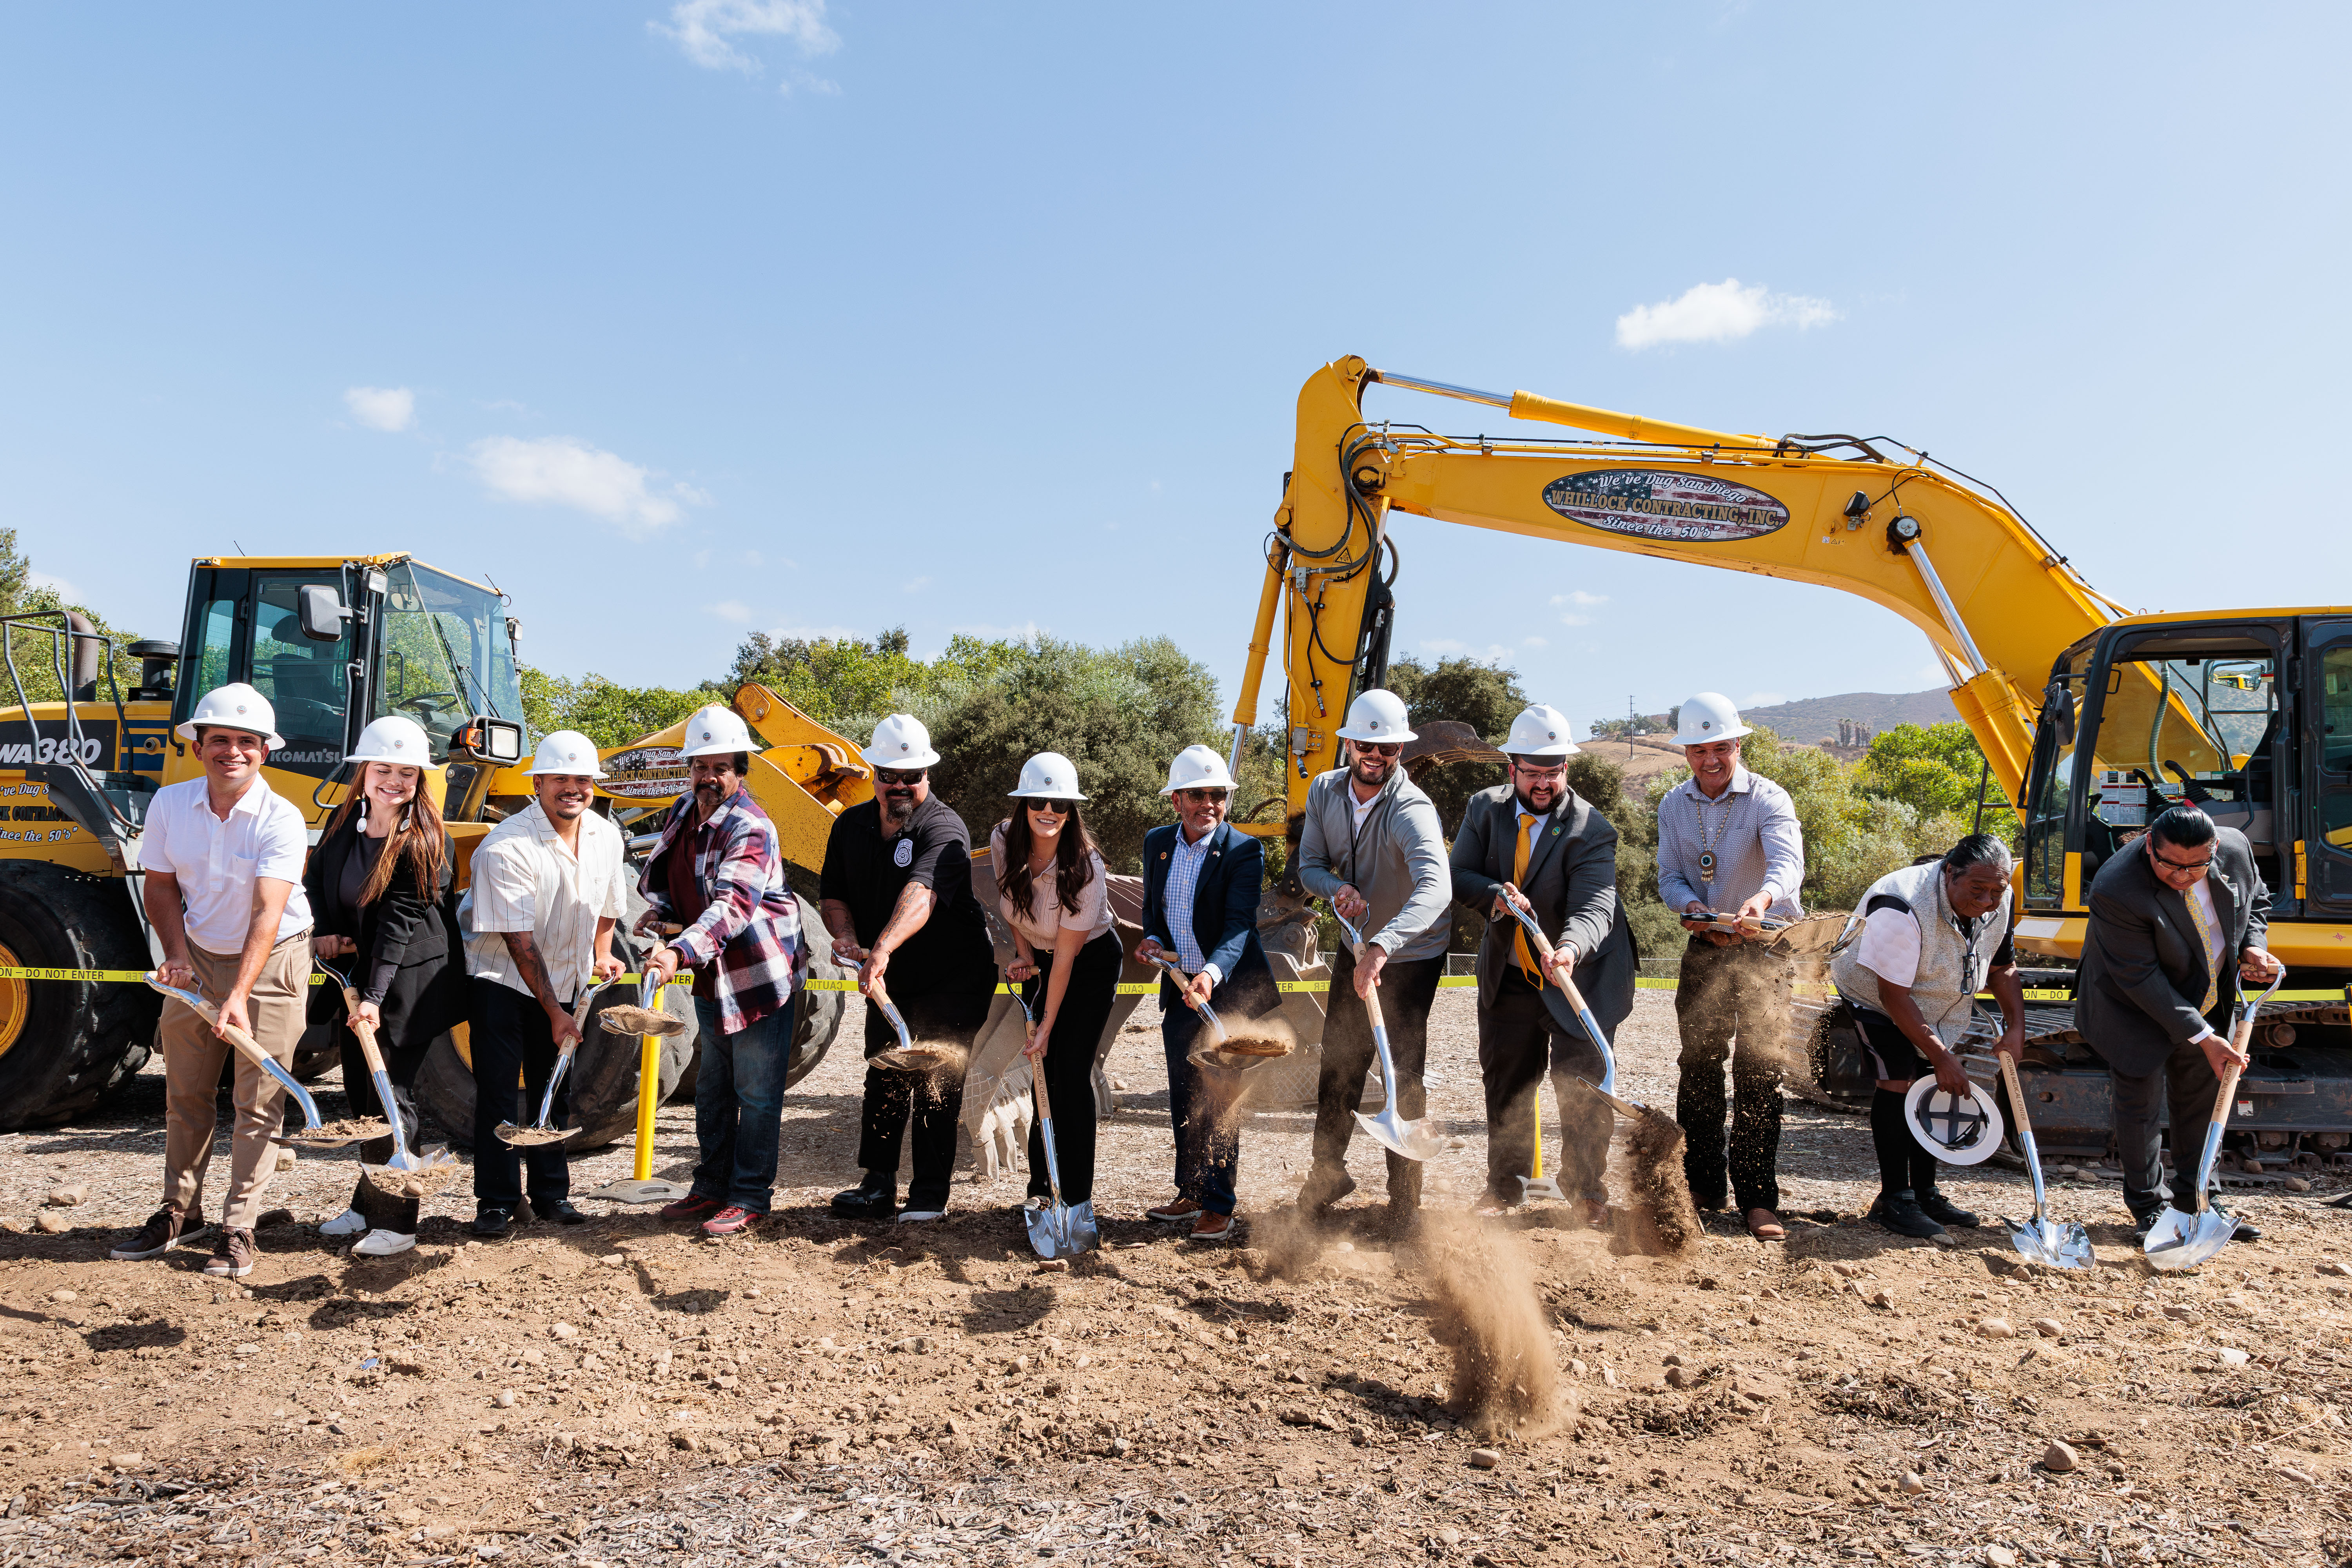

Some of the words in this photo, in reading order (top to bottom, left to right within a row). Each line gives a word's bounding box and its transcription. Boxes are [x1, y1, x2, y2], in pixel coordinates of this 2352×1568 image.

[1645, 474, 1674, 488] Dug
[1676, 476, 1704, 490] San
[1706, 482, 1747, 503] Diego
[1551, 490, 1628, 511] WHILLOCK
[1632, 498, 1744, 526] CONTRACTING,
[1747, 508, 1780, 526] INC.
[1603, 515, 1644, 532] Since
[1648, 524, 1672, 536] the
[642, 750, 656, 760] Dug
[657, 749, 672, 758] San
[19, 784, 40, 797] Dug
[625, 786, 646, 795] Since
[0, 827, 20, 841] ince
[24, 830, 42, 842] the
[26, 968, 40, 978] DO
[45, 969, 67, 978] NOT
[71, 970, 104, 980] ENTER
[674, 975, 691, 984] TER
[1277, 983, 1293, 991] TER
[1372, 999, 1381, 1017] CENTER
[362, 1022, 372, 1042] MEDICAL
[369, 1043, 380, 1061] CENTER
[564, 1035, 573, 1048] CENTER
[1035, 1062, 1044, 1086] MEDICAL
[2222, 1065, 2233, 1089] MEDICAL
[2005, 1055, 2015, 1076] SYCUAN
[2011, 1076, 2021, 1099] MEDICAL
[2017, 1100, 2027, 1121] CENTER
[2215, 1090, 2226, 1112] CENTER
